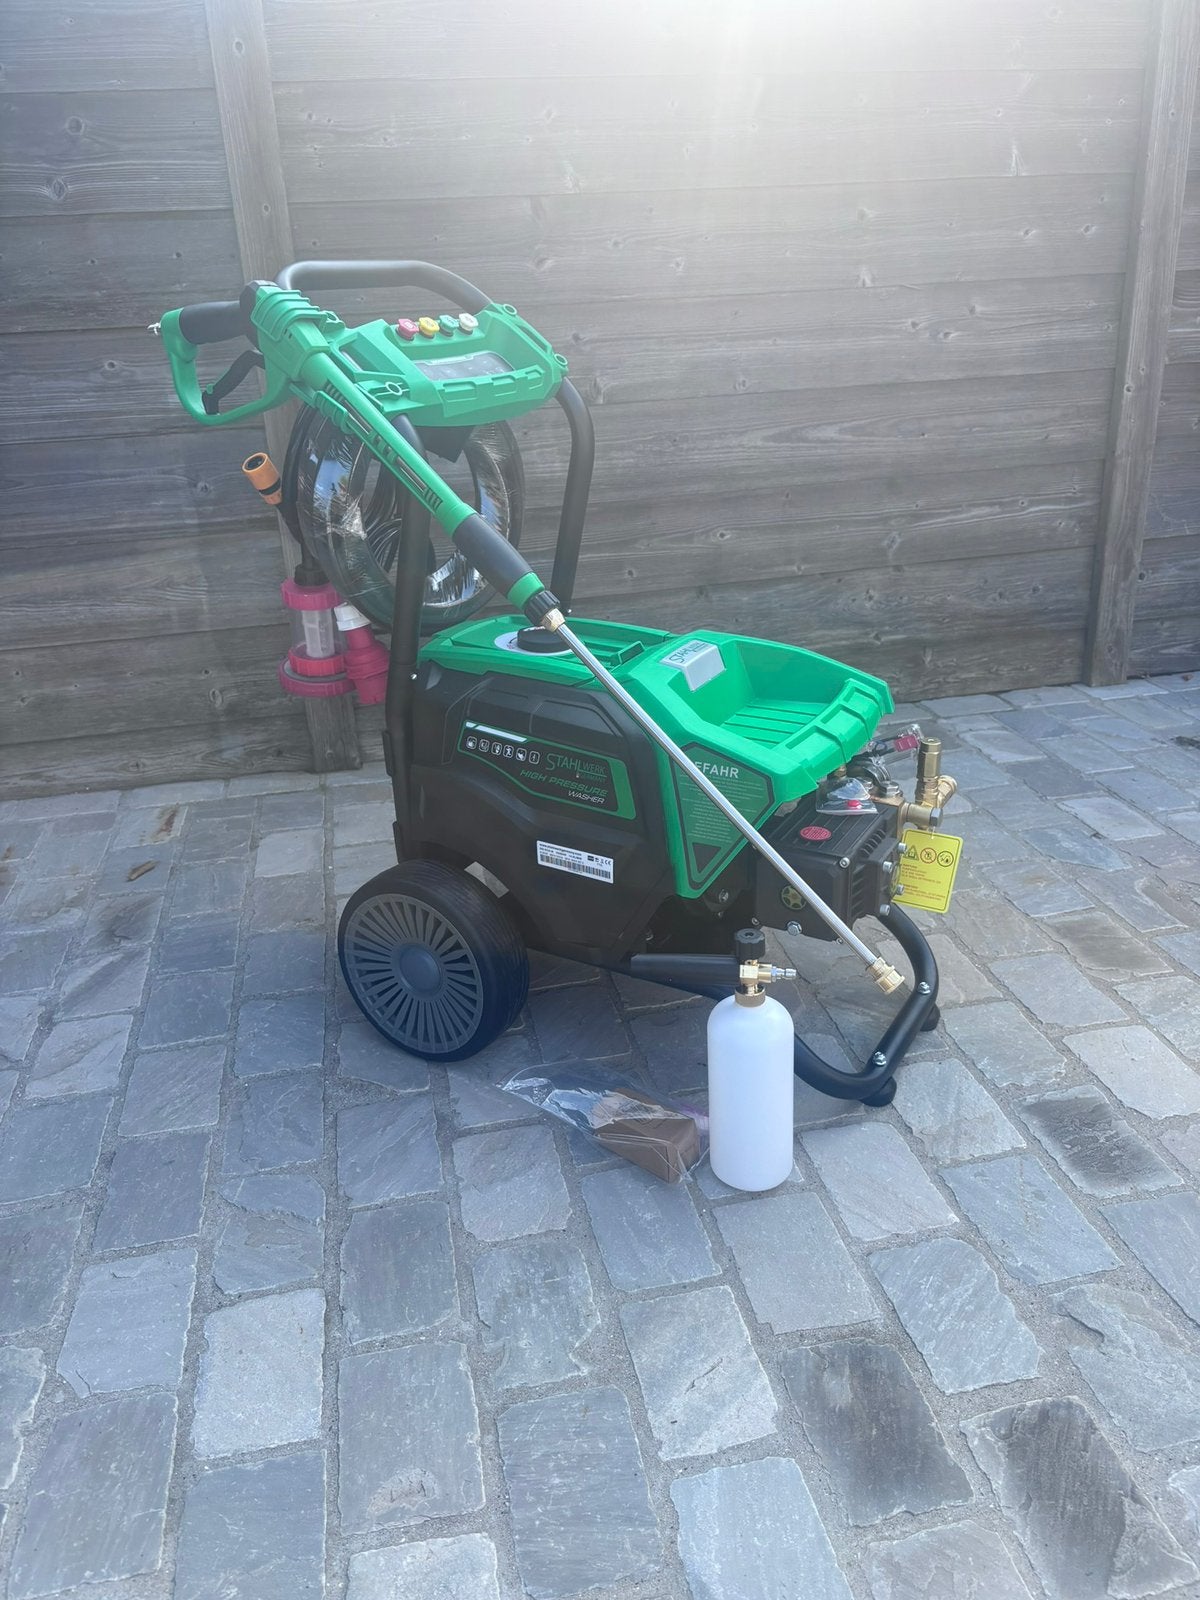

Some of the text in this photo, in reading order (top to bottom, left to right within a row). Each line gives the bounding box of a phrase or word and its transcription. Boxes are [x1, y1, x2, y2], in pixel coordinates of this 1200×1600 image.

[545, 753, 606, 775] STAHLWERK
[520, 769, 609, 797] HIGH PRESSURE
[567, 790, 605, 804] WASHER
